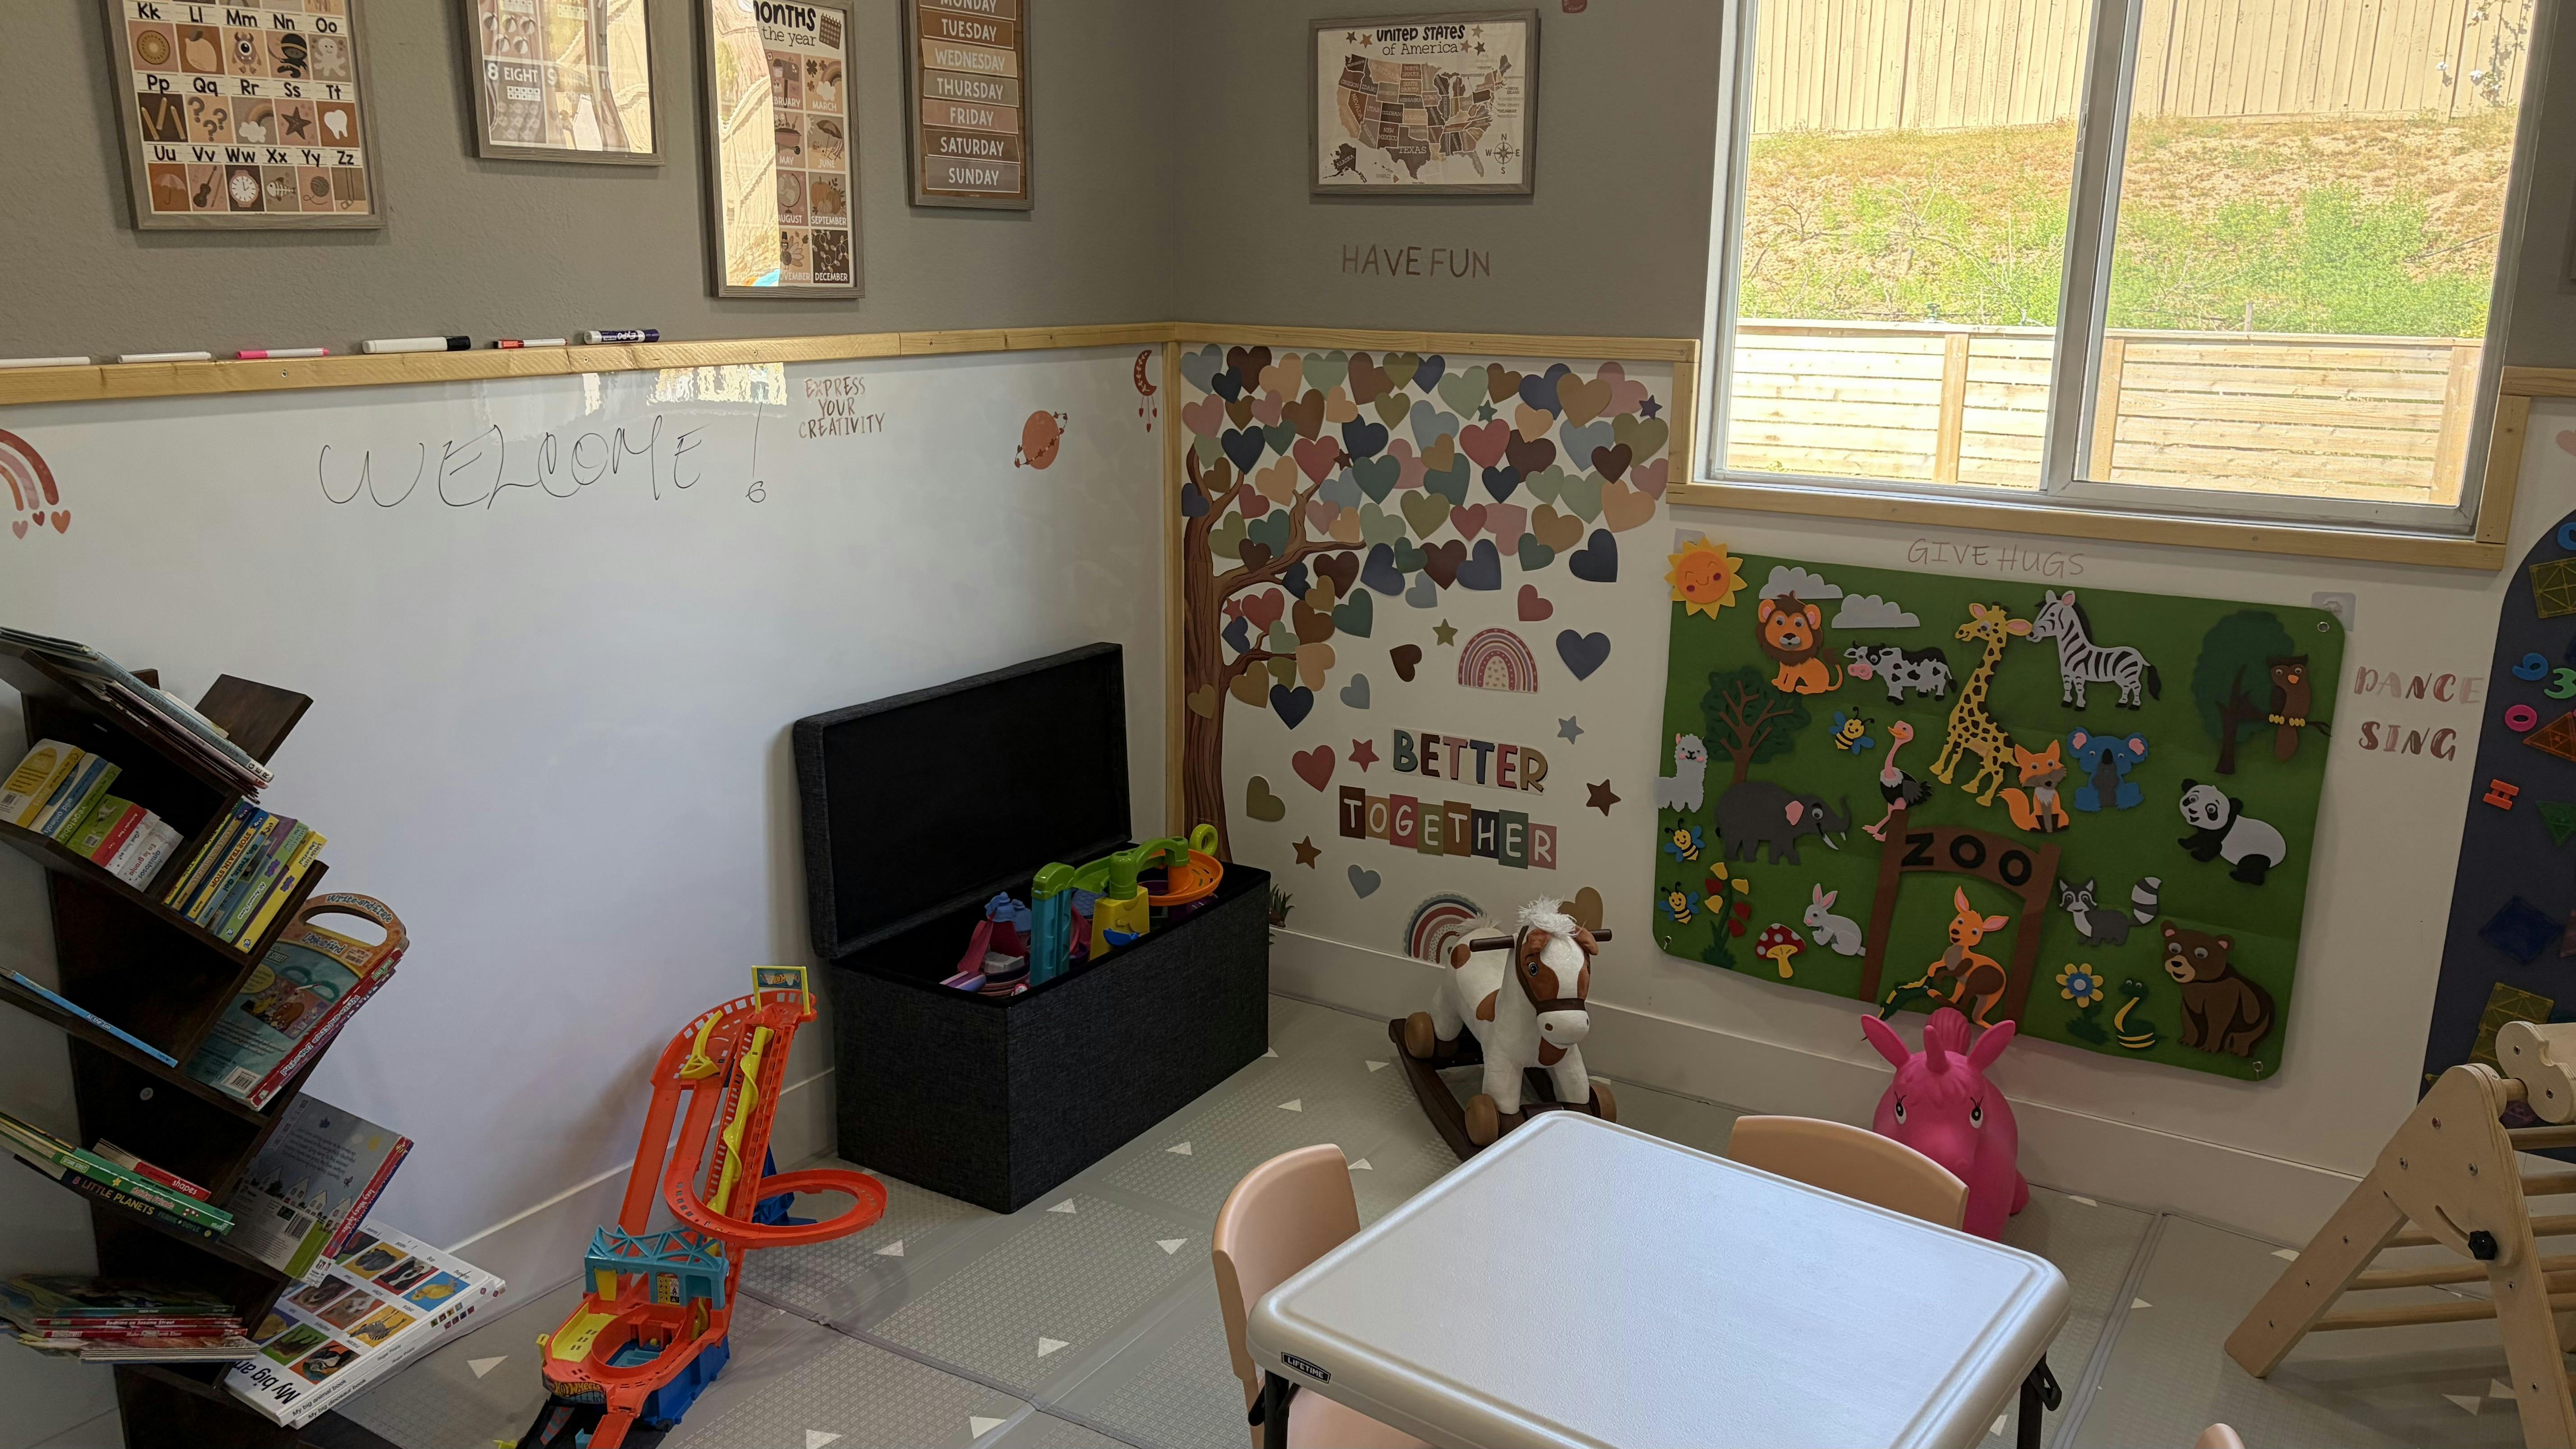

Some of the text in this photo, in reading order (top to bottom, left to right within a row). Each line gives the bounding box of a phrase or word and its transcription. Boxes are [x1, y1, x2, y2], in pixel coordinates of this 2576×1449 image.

[138, 2, 337, 33] Kk Ll Mm Nn Oo
[762, 27, 817, 46] the year
[941, 18, 997, 41] TUESDAY
[1382, 41, 1458, 55] of America
[935, 48, 1005, 71] WEDNESDAY
[488, 63, 538, 82] 8 EIGHT
[547, 68, 557, 85] 9
[1340, 79, 1359, 88] OREGON
[147, 74, 340, 100] Pp Qq Rr Ss Tt
[937, 78, 1003, 100] THURSDAY
[813, 101, 837, 111] MARCH
[950, 107, 994, 126] FRIDAY
[1352, 93, 1363, 120] NEVADA
[154, 145, 354, 167] Uu Vv Ww Xx Yy Zz
[940, 137, 1004, 156] SATURDAY
[1398, 146, 1426, 154] TEXAS
[779, 156, 794, 166] MAY
[818, 159, 835, 169] JUNE
[1336, 154, 1355, 168] ALASKA
[948, 168, 999, 186] SUNDAY
[811, 216, 846, 225] SEPTEMBER
[1343, 244, 1490, 278] HAVE FUN
[815, 272, 848, 281] DECEMBER
[804, 377, 865, 398] EXPRESS
[818, 397, 855, 417] YOUR
[799, 412, 885, 439] CREATIVITY
[1908, 538, 2084, 579] GIVE HUGS
[2354, 666, 2484, 704] DANCE
[208, 735, 240, 758] GERSTEIN
[2359, 721, 2457, 761] SING
[1393, 729, 1548, 793] BETTER
[43, 797, 74, 835] wild animals
[55, 804, 89, 845] vegetables
[1343, 798, 1552, 862] TOGETHER
[143, 850, 151, 858] la
[147, 842, 156, 852] En
[127, 856, 146, 877] granja
[138, 849, 161, 880] amistosos
[209, 831, 251, 888] STOP, TRAIN, STOP!
[221, 842, 259, 892] Go, Train, Go!
[1901, 833, 2032, 886] ZOO
[247, 889, 261, 907] Around
[325, 938, 346, 955] Find
[71, 1174, 82, 1186] 8
[81, 1178, 114, 1200] LITTLE
[112, 1191, 155, 1218] PLANETS
[171, 1177, 198, 1196] shapes
[339, 1214, 357, 1234] Spider
[1288, 1357, 1324, 1379] LIFETIME
[247, 1362, 303, 1409] My big
[554, 1382, 600, 1396] HOT WHEELS
[291, 1379, 347, 1416] My big animal book
[307, 1378, 366, 1420] My big dinosaur book
